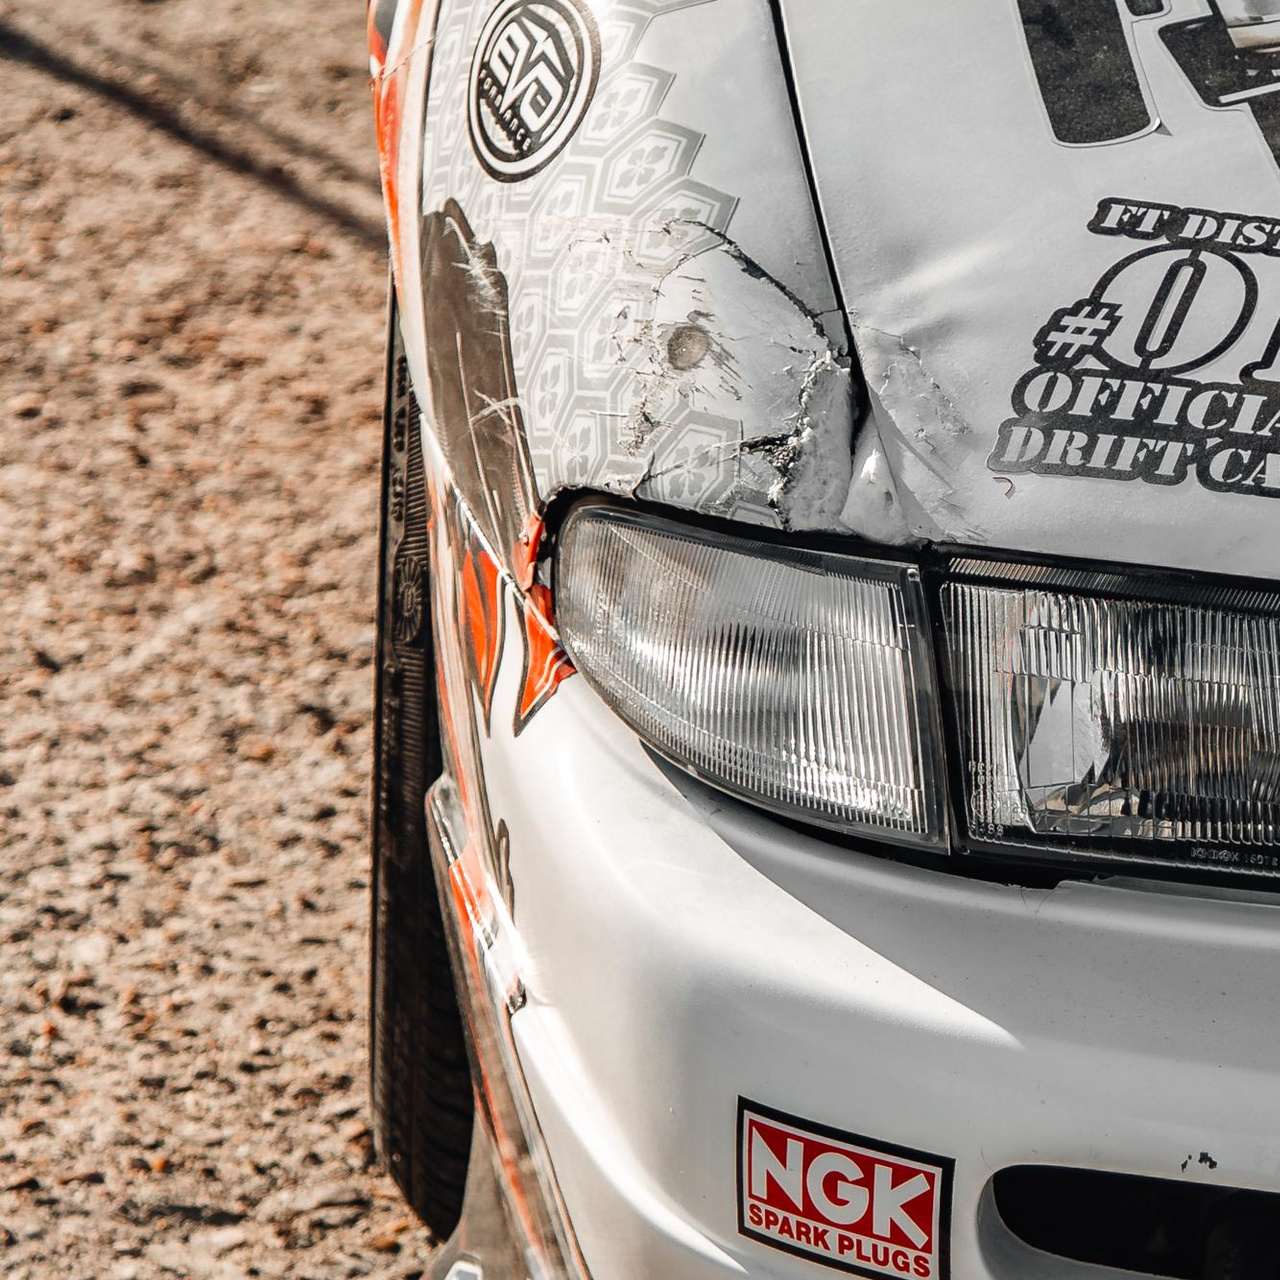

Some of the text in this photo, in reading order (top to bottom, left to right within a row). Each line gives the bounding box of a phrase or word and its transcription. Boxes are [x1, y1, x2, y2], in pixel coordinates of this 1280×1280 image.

[1101, 203, 1171, 234] FT
[1000, 425, 1196, 477] DRIFT
[751, 1125, 932, 1250] NGK
[748, 1203, 931, 1278] SPARK PLUGS
